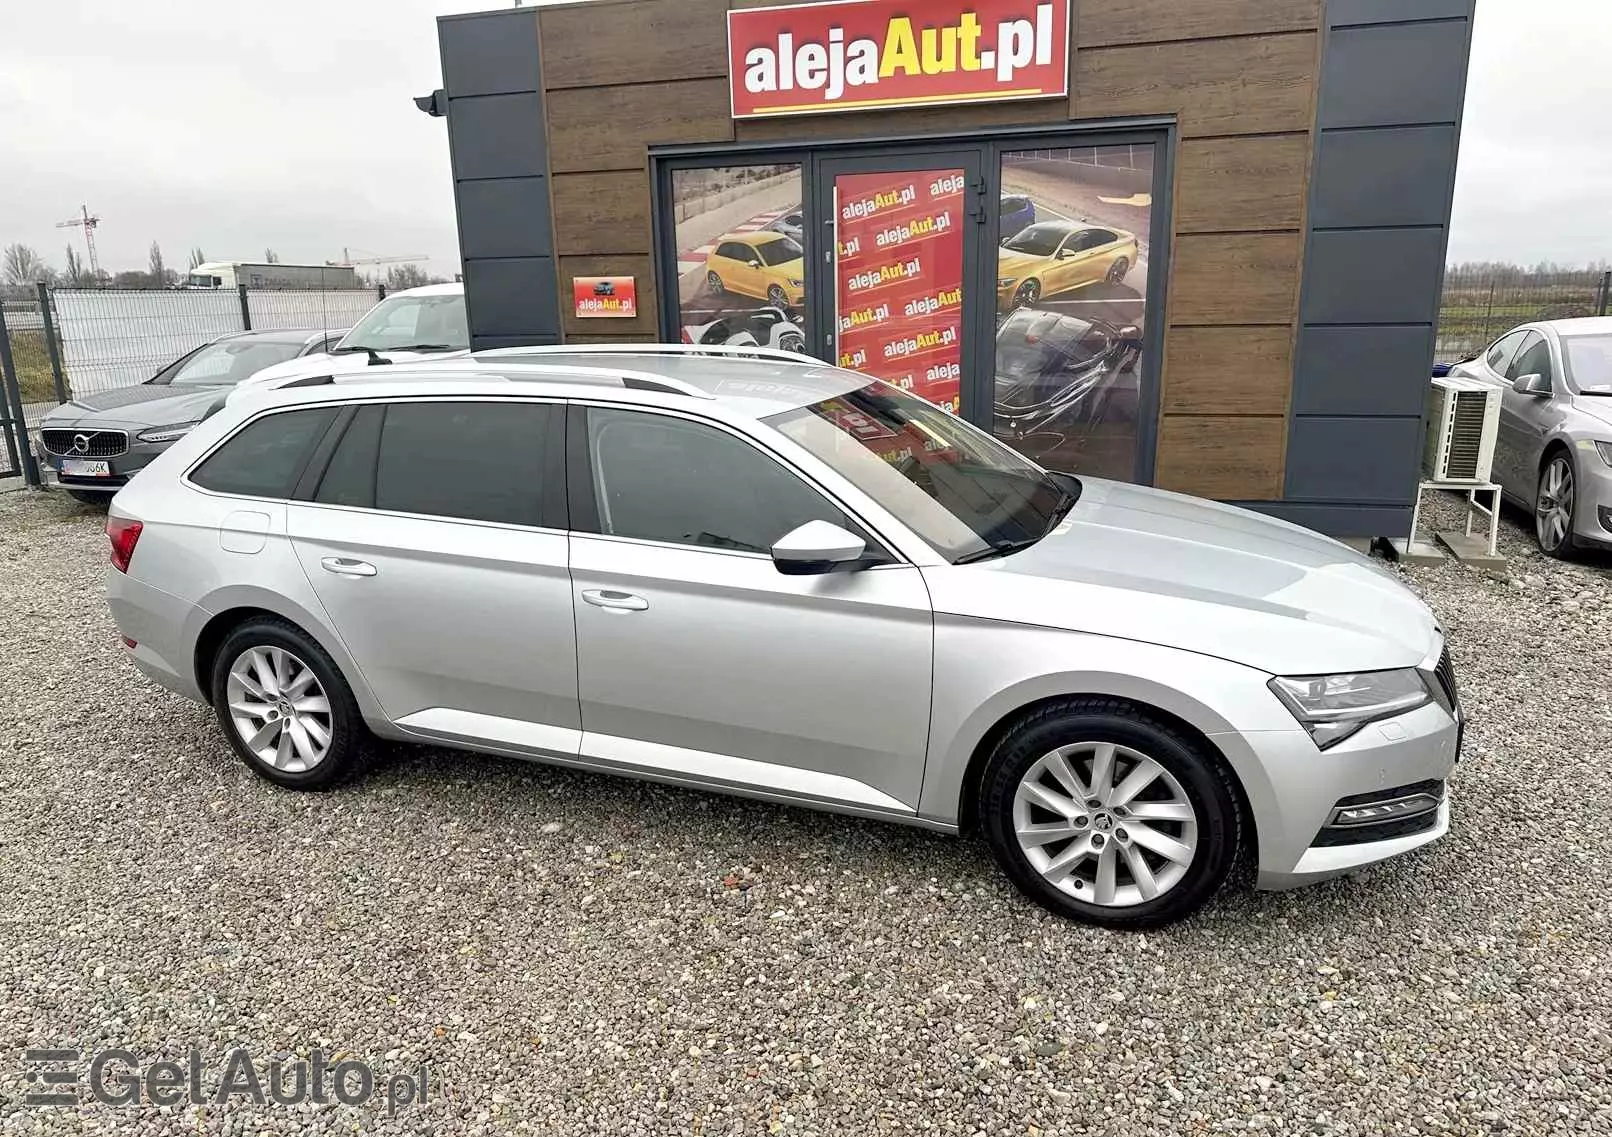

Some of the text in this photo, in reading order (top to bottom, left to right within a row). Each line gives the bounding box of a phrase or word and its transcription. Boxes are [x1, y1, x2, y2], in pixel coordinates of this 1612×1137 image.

[744, 3, 1053, 100] alejaAut.pl
[929, 174, 965, 196] aleja
[842, 184, 916, 220] alejaAut.pl
[876, 211, 951, 246] alejaAut.pl
[848, 257, 921, 290] alejaAut.pl
[578, 297, 633, 312] alejaAut.pl
[883, 326, 956, 357] alejaAut.pl
